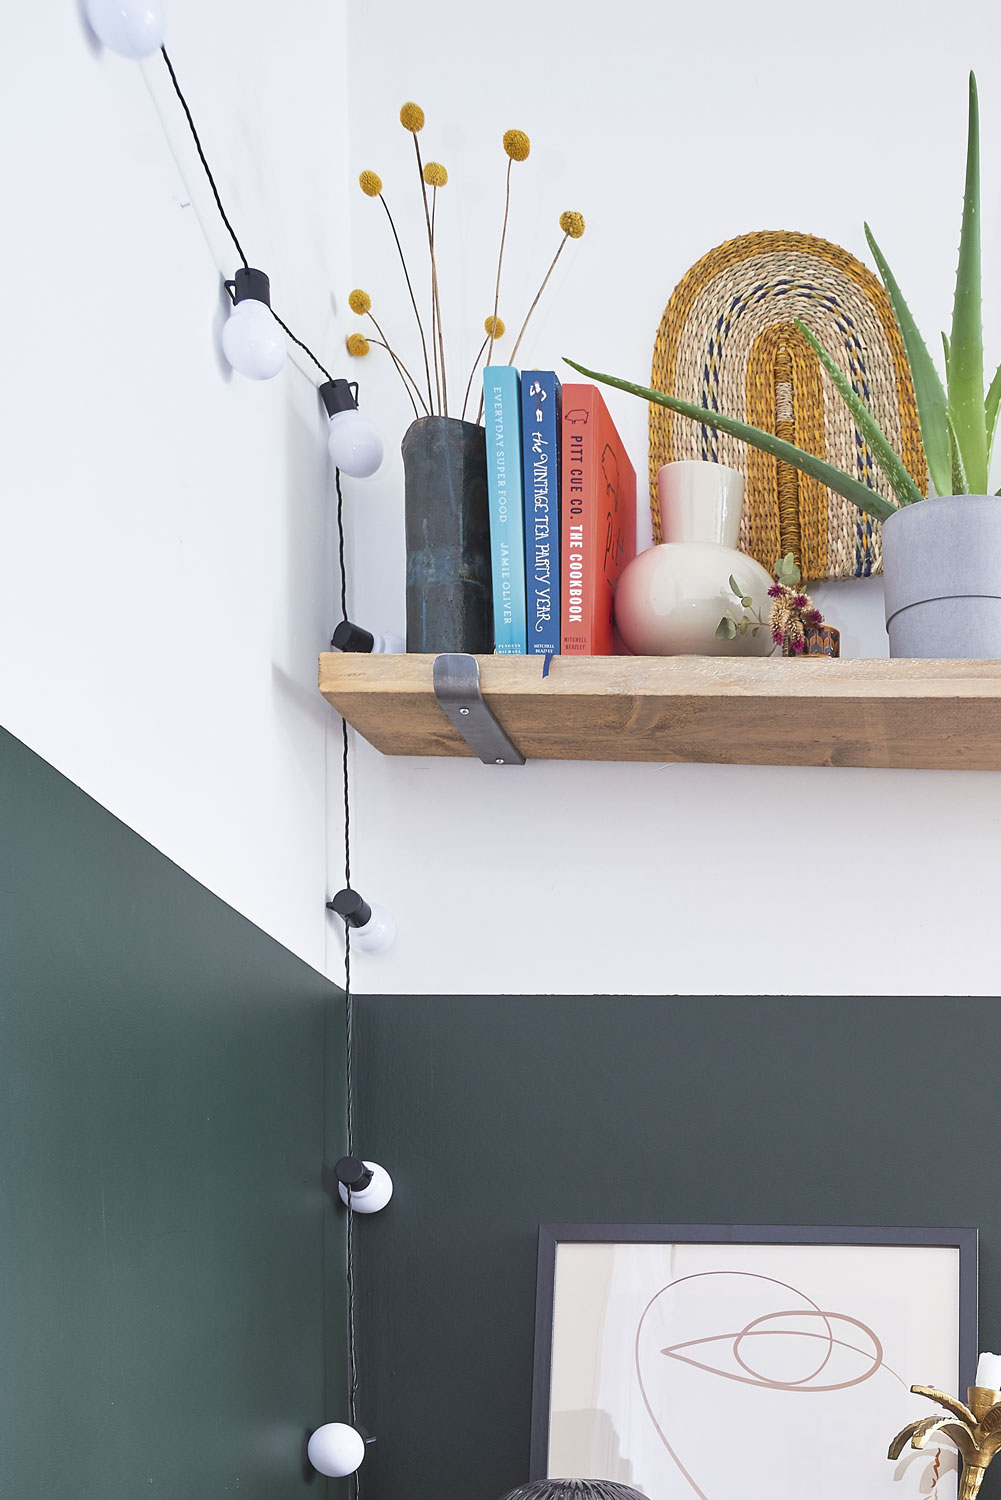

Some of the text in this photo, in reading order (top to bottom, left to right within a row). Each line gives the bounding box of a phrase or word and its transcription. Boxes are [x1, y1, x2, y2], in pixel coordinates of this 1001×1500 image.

[493, 386, 508, 523] EVERYDAY SUPER FOOD
[569, 435, 583, 520] PITT CUE CO.
[531, 431, 551, 633] the VINTAGE TEA PARTY YEAR
[568, 525, 583, 623] THE COOKBOOK
[500, 542, 512, 625] JAMIE OLIVER
